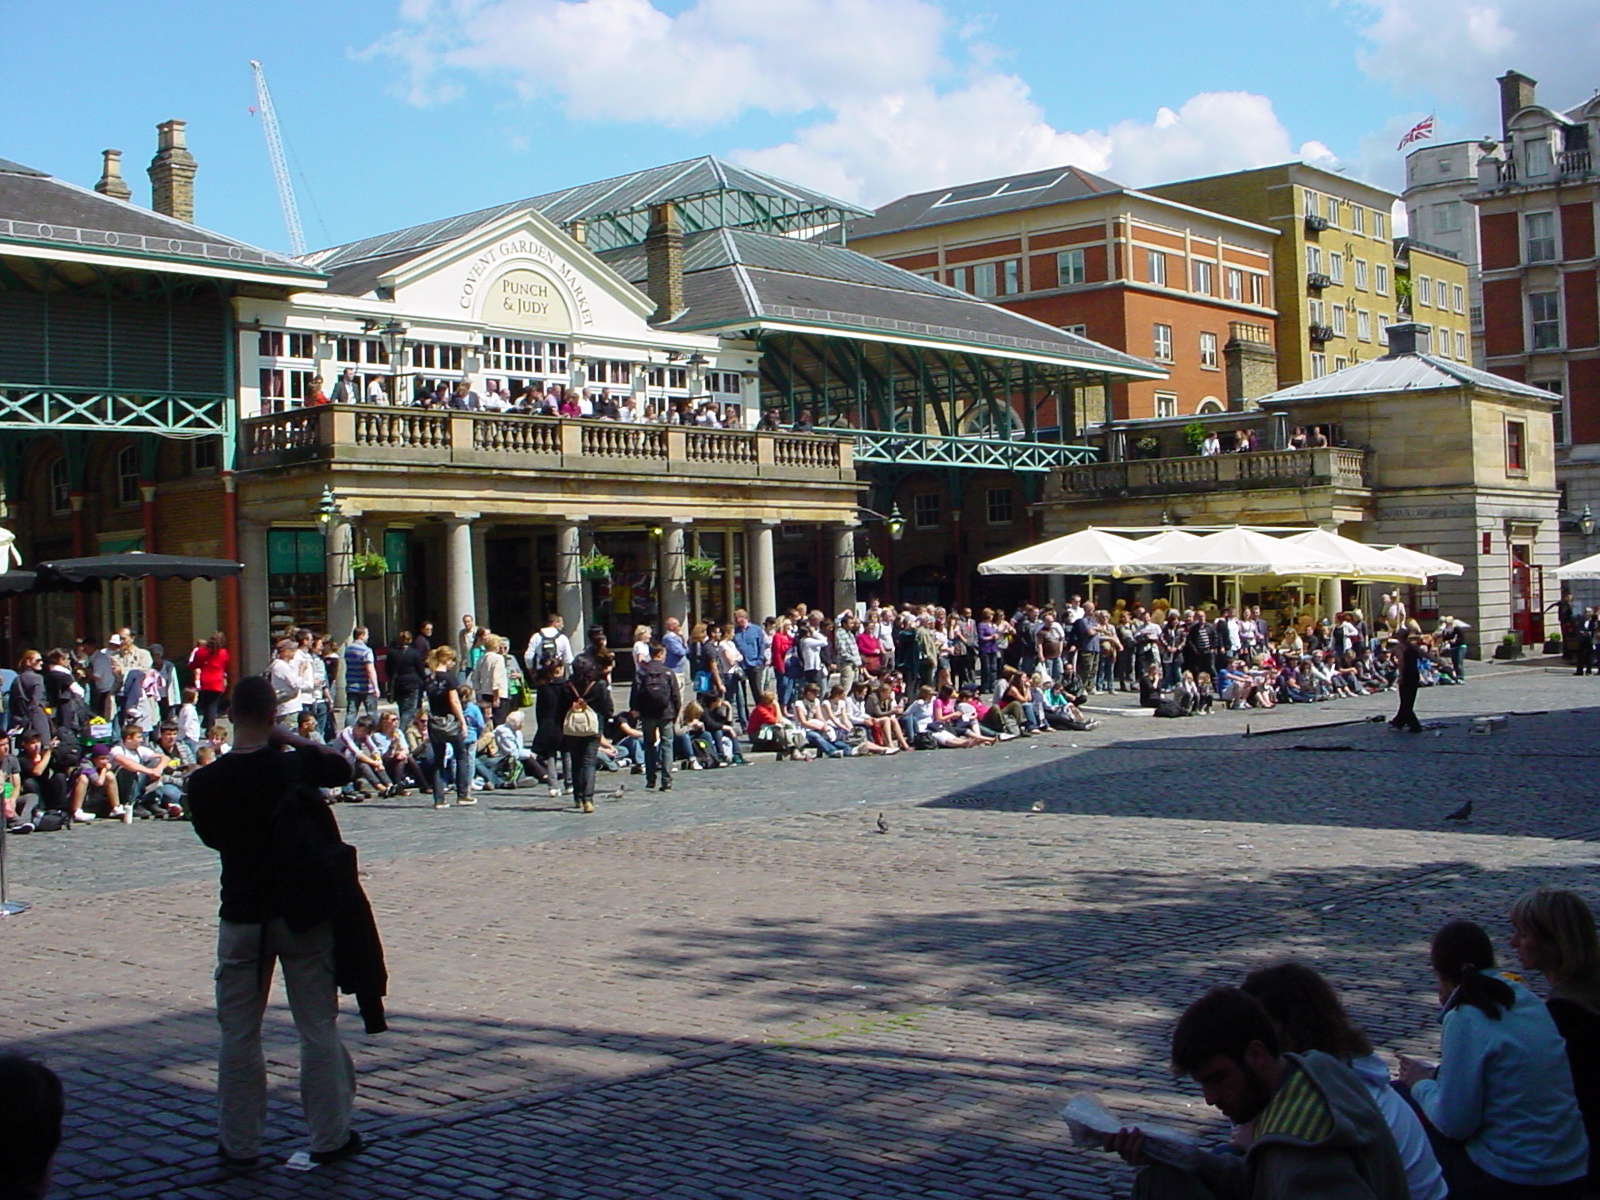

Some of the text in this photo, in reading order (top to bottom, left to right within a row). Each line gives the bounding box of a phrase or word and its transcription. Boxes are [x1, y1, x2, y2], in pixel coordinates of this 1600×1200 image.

[460, 240, 593, 326] COVENT GARDEN MARKET
[503, 279, 547, 298] PUNCH
[503, 297, 549, 315] & JUDY
